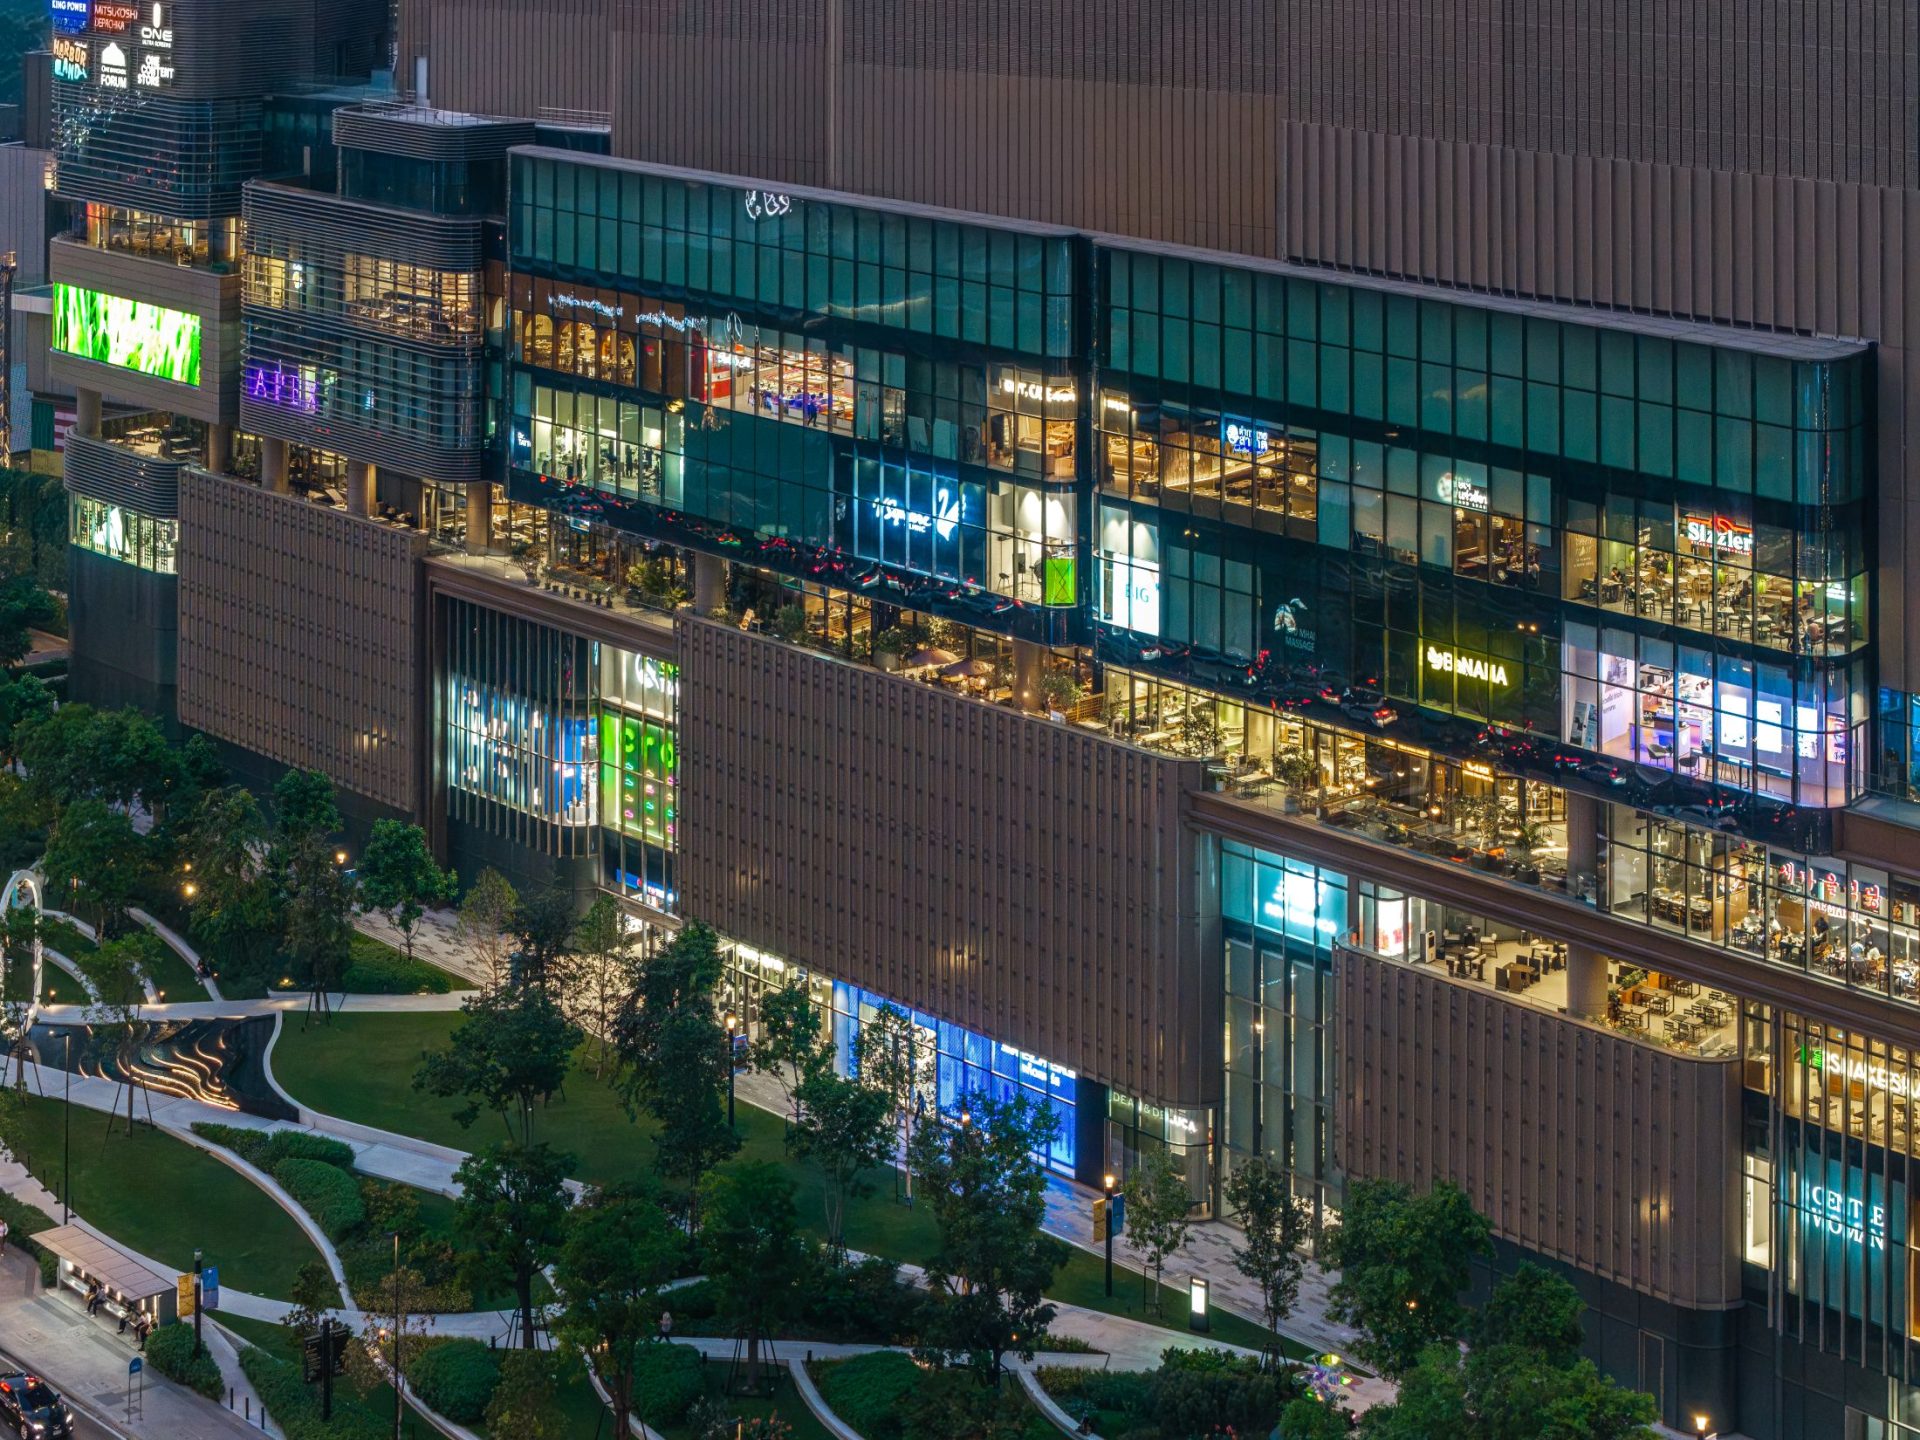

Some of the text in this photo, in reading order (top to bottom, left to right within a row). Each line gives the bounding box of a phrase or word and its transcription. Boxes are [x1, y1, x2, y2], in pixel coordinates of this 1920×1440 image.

[51, 1, 87, 12] KING POWER
[94, 5, 138, 20] MITSUKOSHI
[141, 27, 173, 42] ONE
[53, 38, 87, 67] HARBOR
[141, 64, 175, 79] CONTENT
[101, 74, 127, 89] FORUM
[1687, 521, 1754, 552] Sizzler
